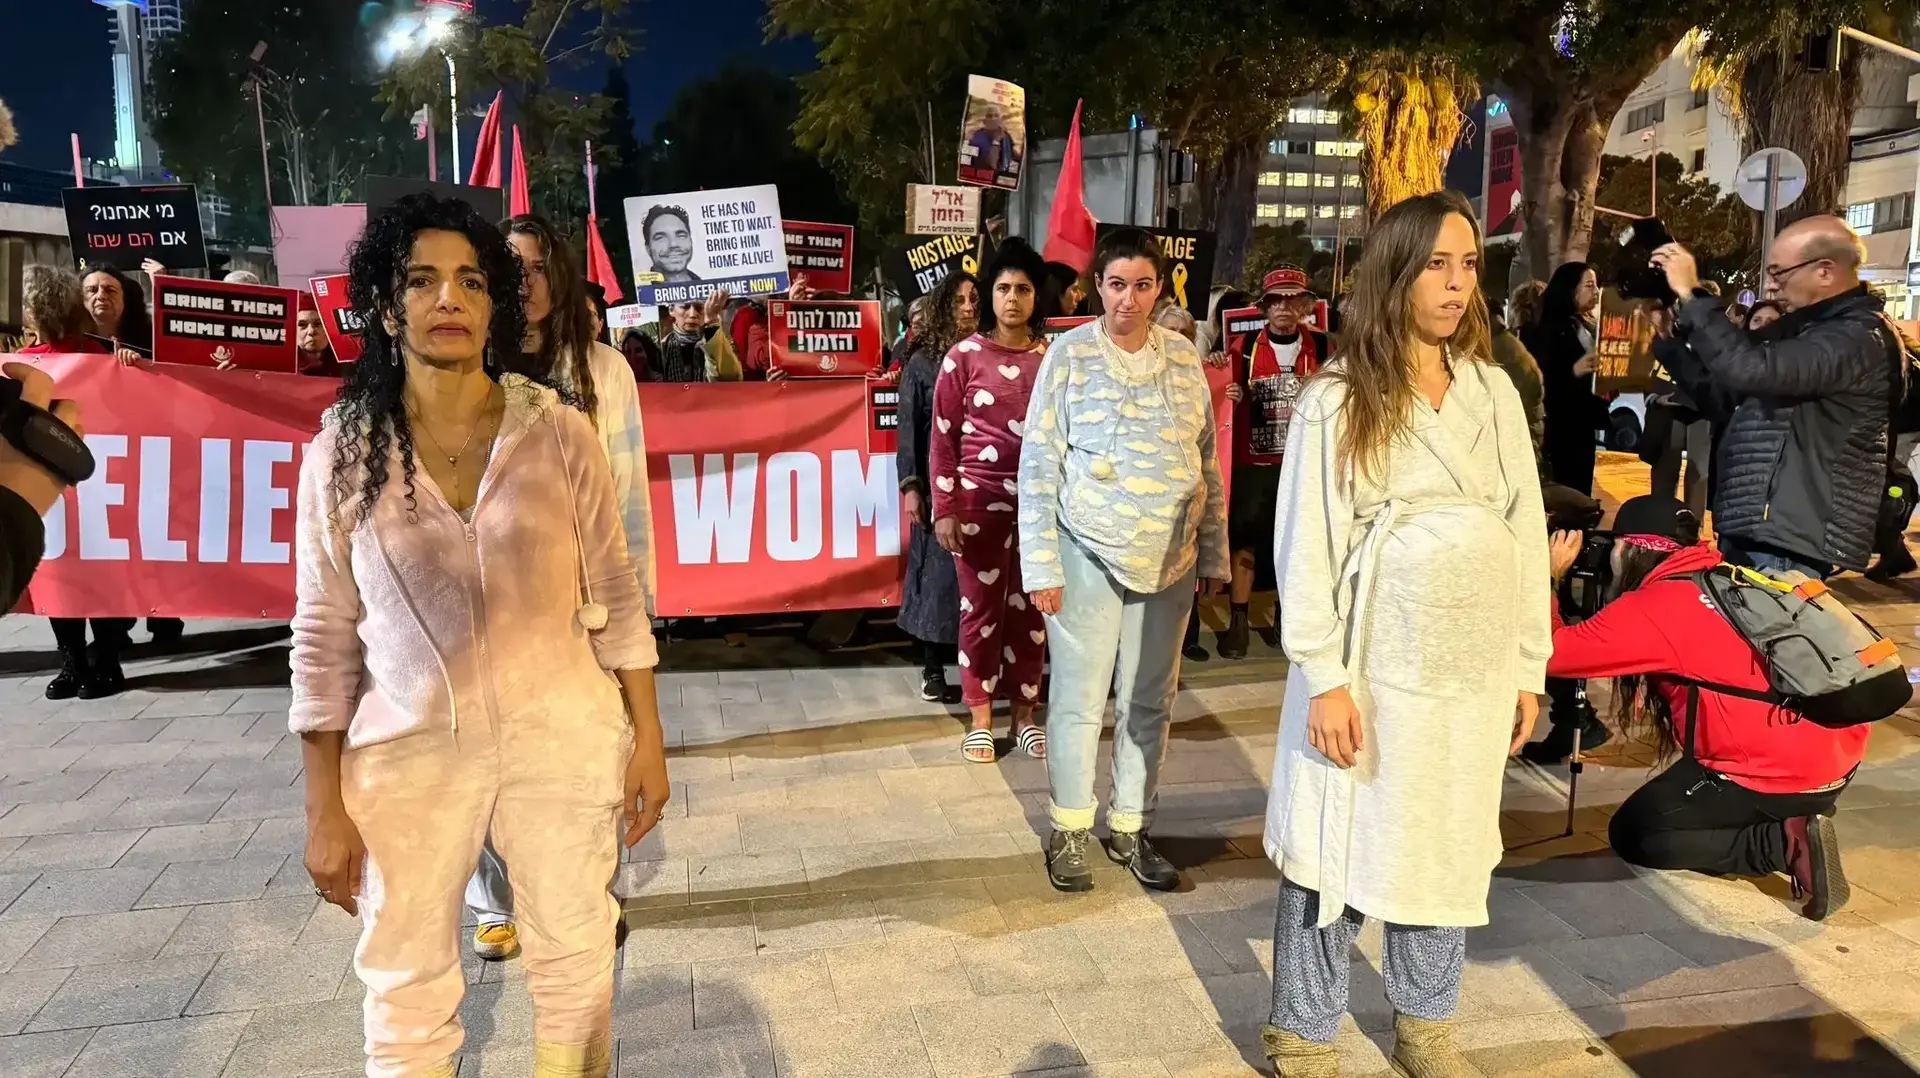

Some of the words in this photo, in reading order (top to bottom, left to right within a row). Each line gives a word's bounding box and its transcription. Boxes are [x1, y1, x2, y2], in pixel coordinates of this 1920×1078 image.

[90, 204, 150, 220] אנחנו?
[155, 204, 175, 218] מי
[702, 205, 715, 218] HE
[718, 202, 739, 217] HAS
[741, 201, 755, 215] NO
[930, 208, 964, 224] הזמן
[703, 220, 730, 235] TIME
[731, 219, 745, 232] TO
[746, 216, 775, 231] WAIT.
[87, 233, 121, 248] שם!
[128, 232, 154, 246] הם
[160, 231, 187, 245] אם
[706, 237, 738, 252] BRING
[740, 234, 760, 249] HIM
[808, 236, 843, 248] THEM
[709, 253, 739, 269] HOME
[741, 250, 774, 265] ALIVE!
[906, 234, 975, 271] HOSTAGE
[787, 255, 803, 265] ME
[808, 256, 844, 268] NOW!
[654, 285, 687, 301] BRING
[689, 283, 715, 299] OFER
[749, 277, 777, 292] NOW!
[164, 293, 224, 311] BRING
[231, 300, 284, 316] THEM
[827, 311, 862, 328] נגמר
[1230, 320, 1269, 332] BRIN
[170, 320, 225, 337] HOME
[231, 325, 287, 342] NOW!
[797, 330, 853, 353] הזמן!
[874, 392, 900, 404] BRI
[41, 434, 312, 563] ELIE
[668, 449, 901, 564] WOM
